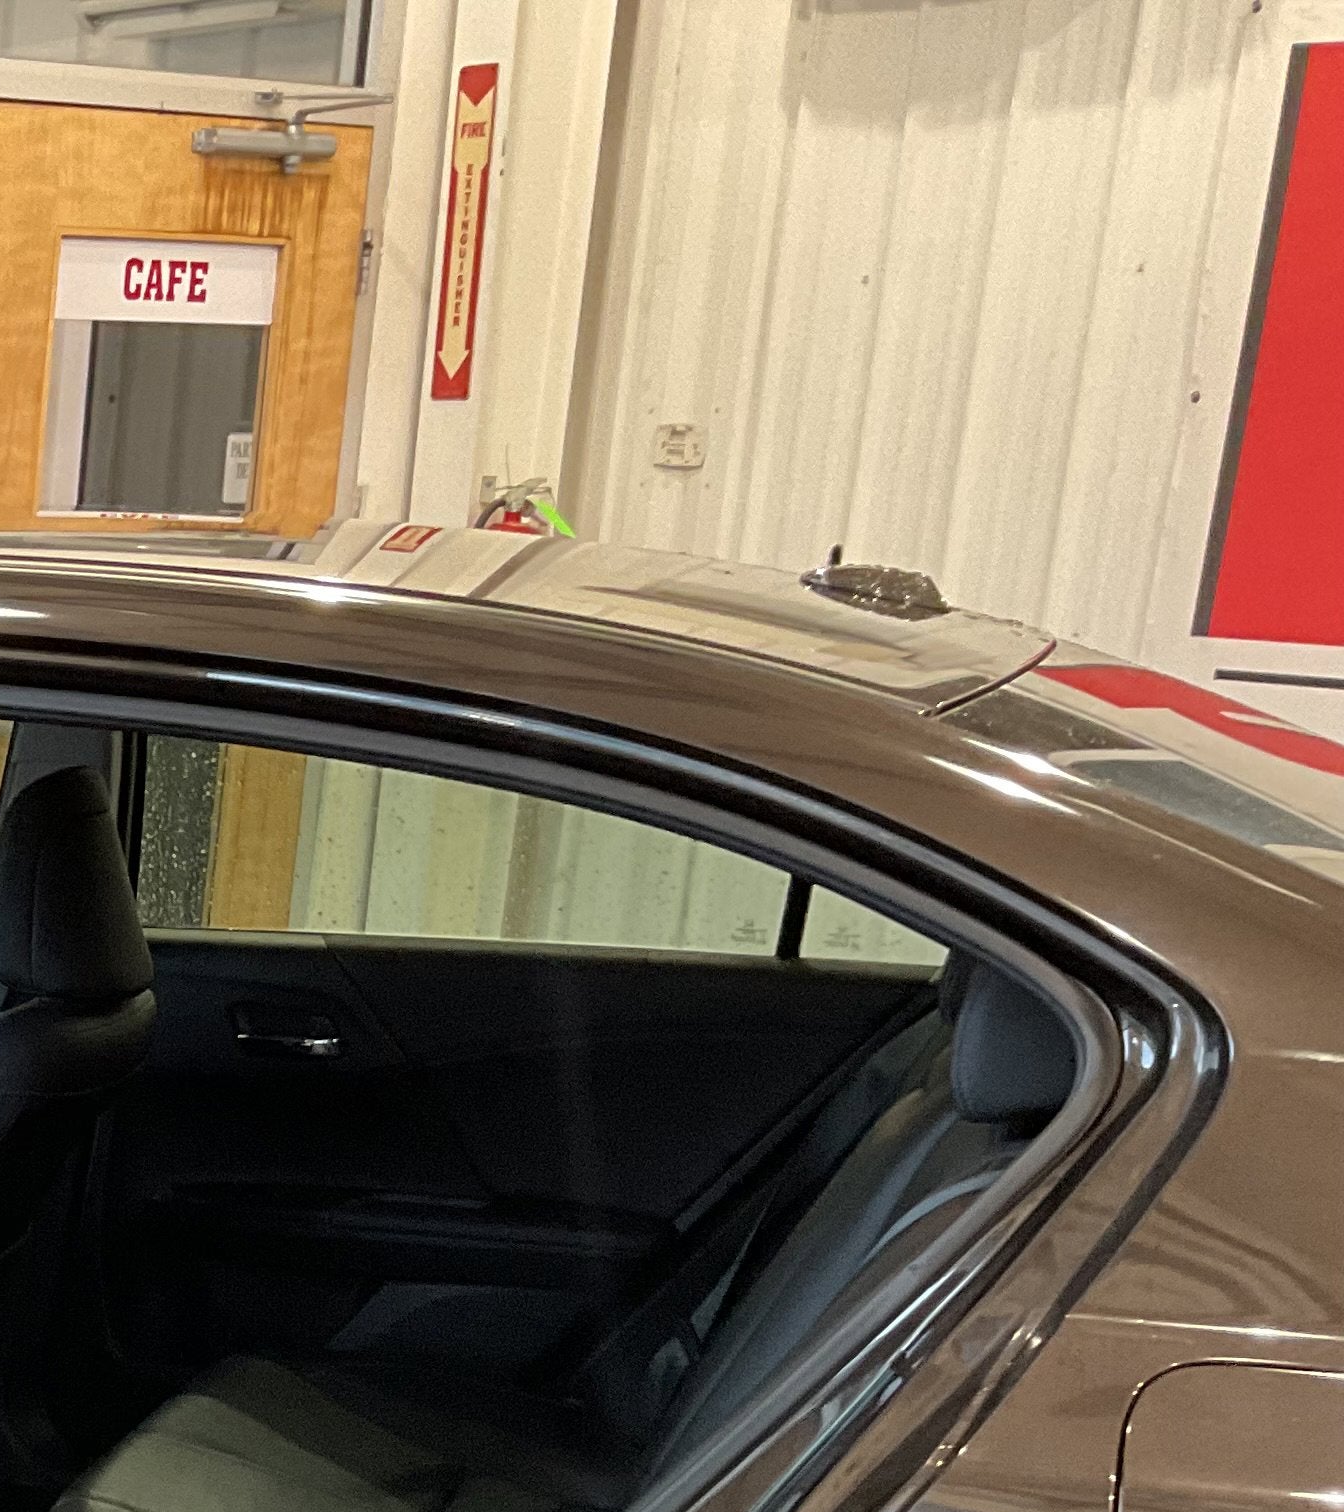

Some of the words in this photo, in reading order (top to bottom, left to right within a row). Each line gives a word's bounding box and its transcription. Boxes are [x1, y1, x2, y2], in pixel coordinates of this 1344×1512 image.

[461, 121, 487, 138] FIRE
[452, 163, 475, 326] EXTINGUISHER
[123, 257, 209, 303] CAFE
